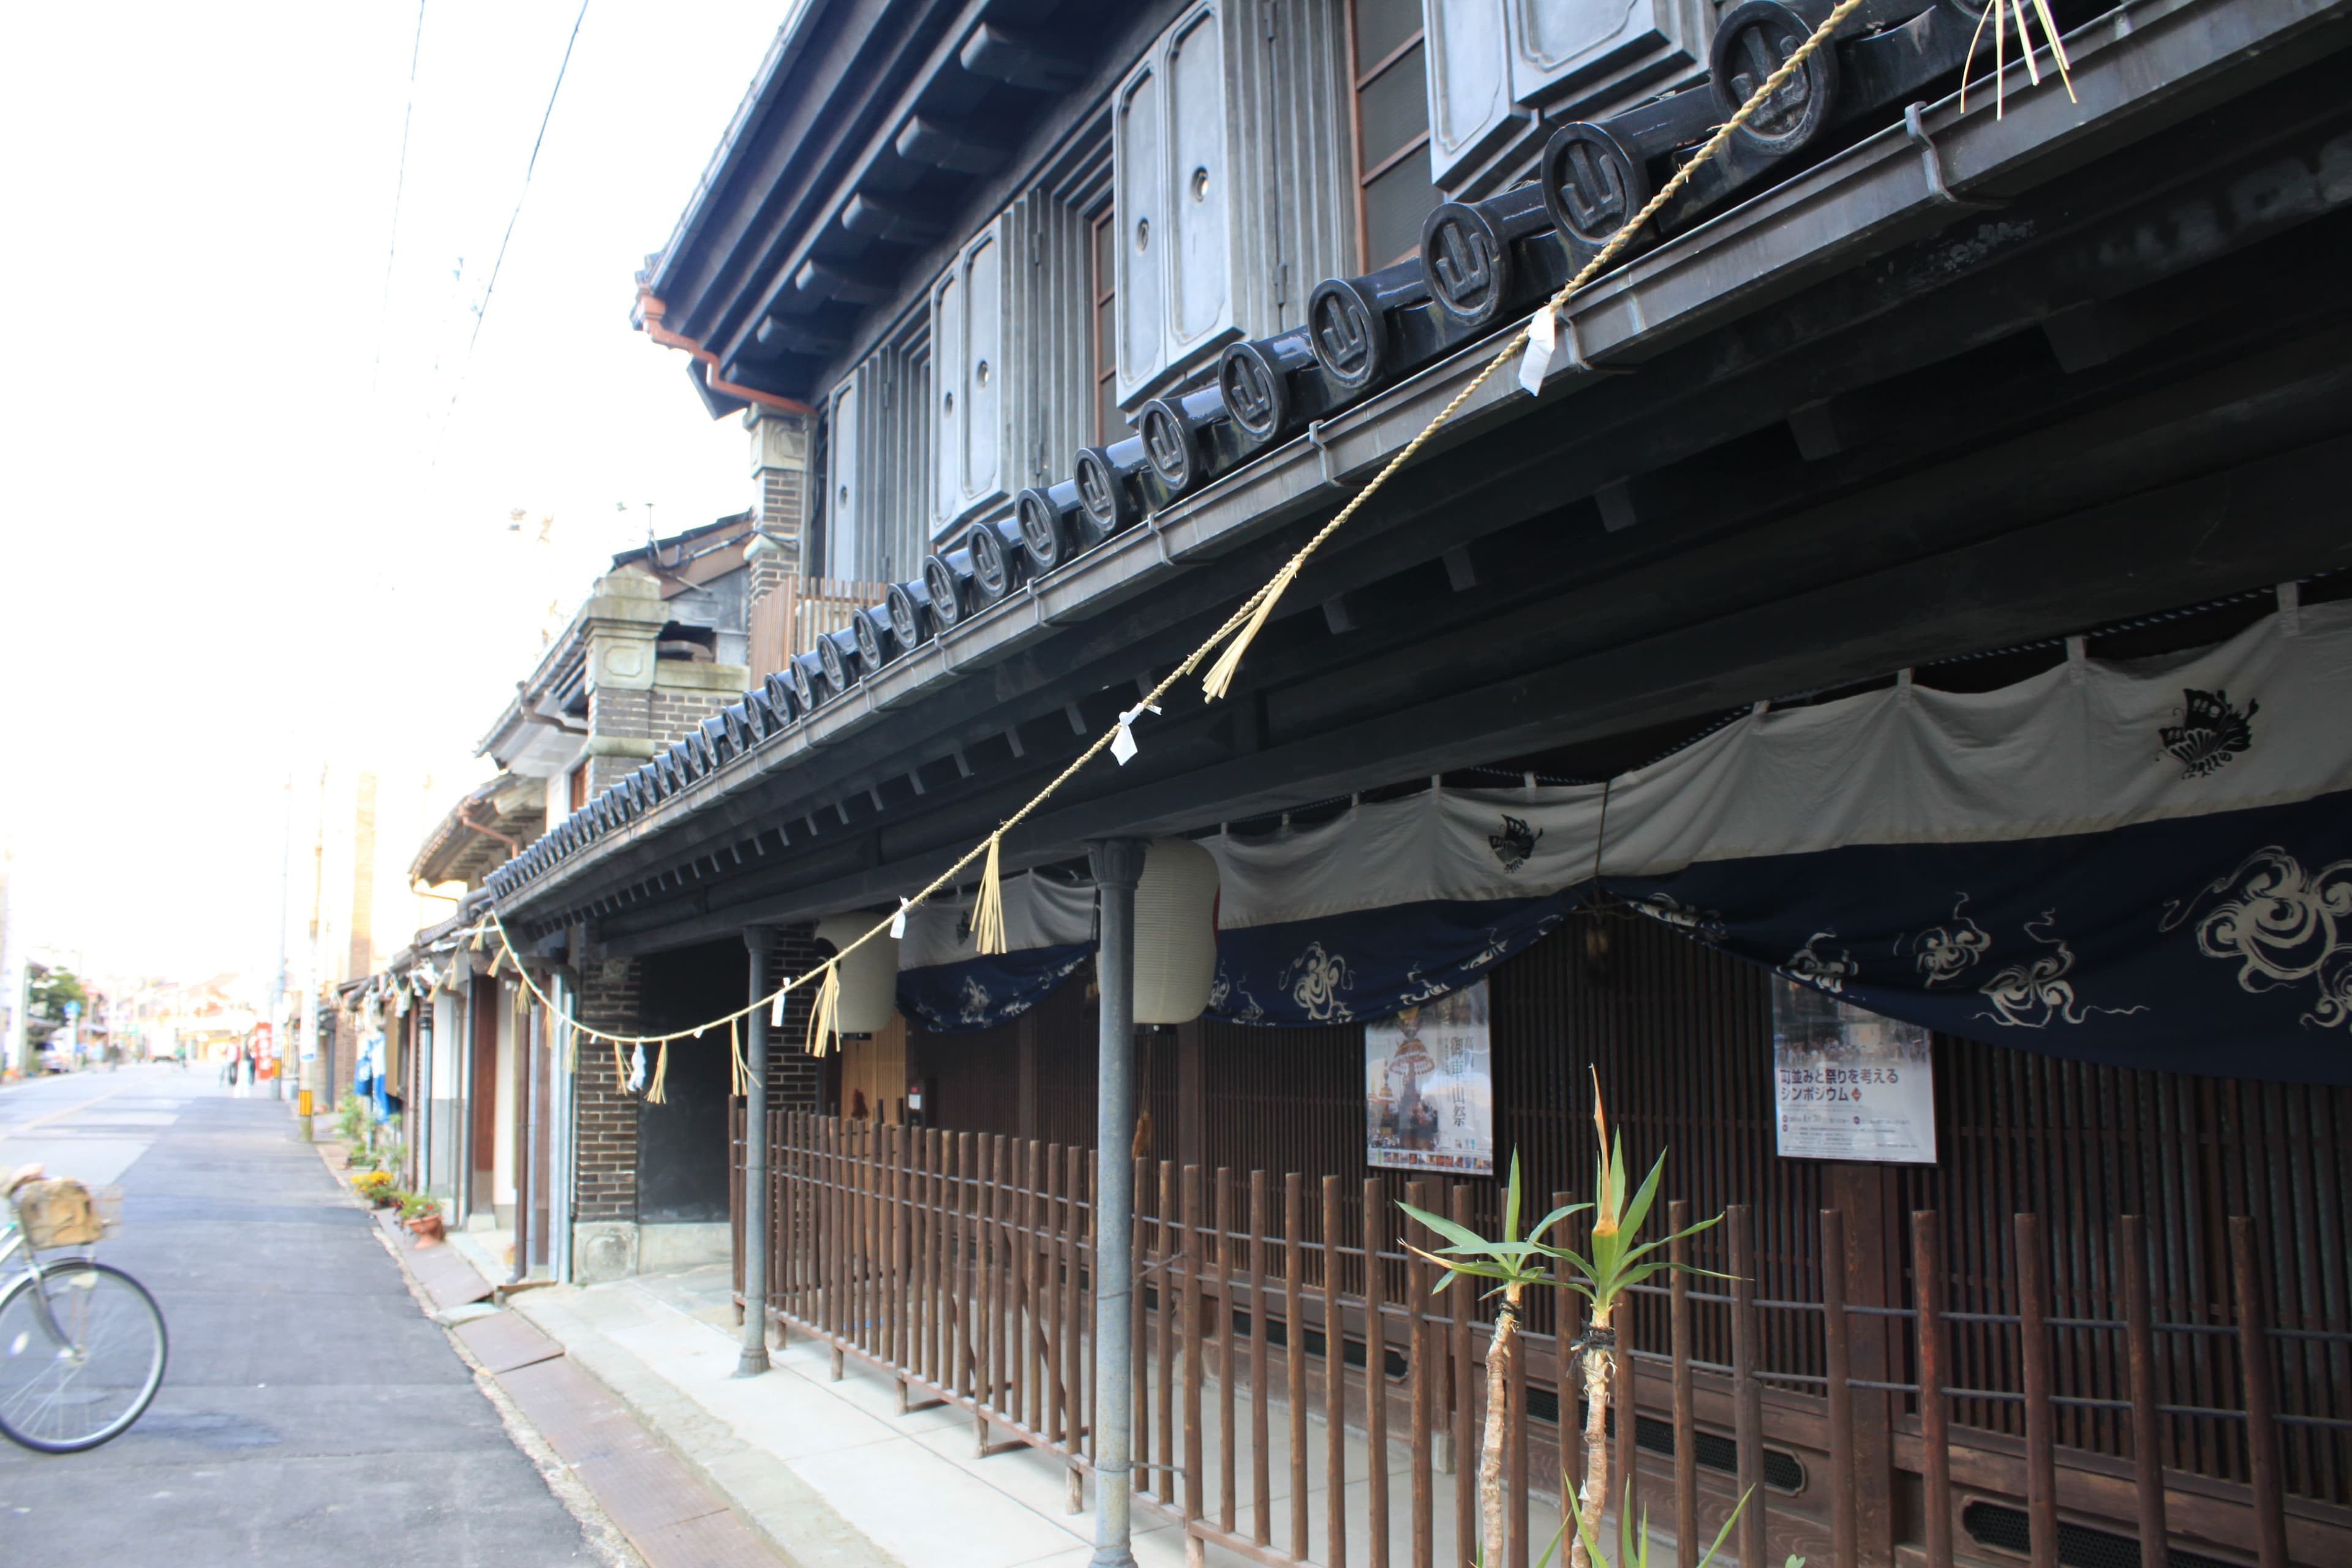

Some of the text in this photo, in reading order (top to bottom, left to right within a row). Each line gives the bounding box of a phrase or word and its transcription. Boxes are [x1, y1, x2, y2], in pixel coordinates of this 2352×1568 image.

[1780, 1068, 1899, 1085] 町並みと祭りを考える
[1781, 1087, 1849, 1102] シンポジウム
